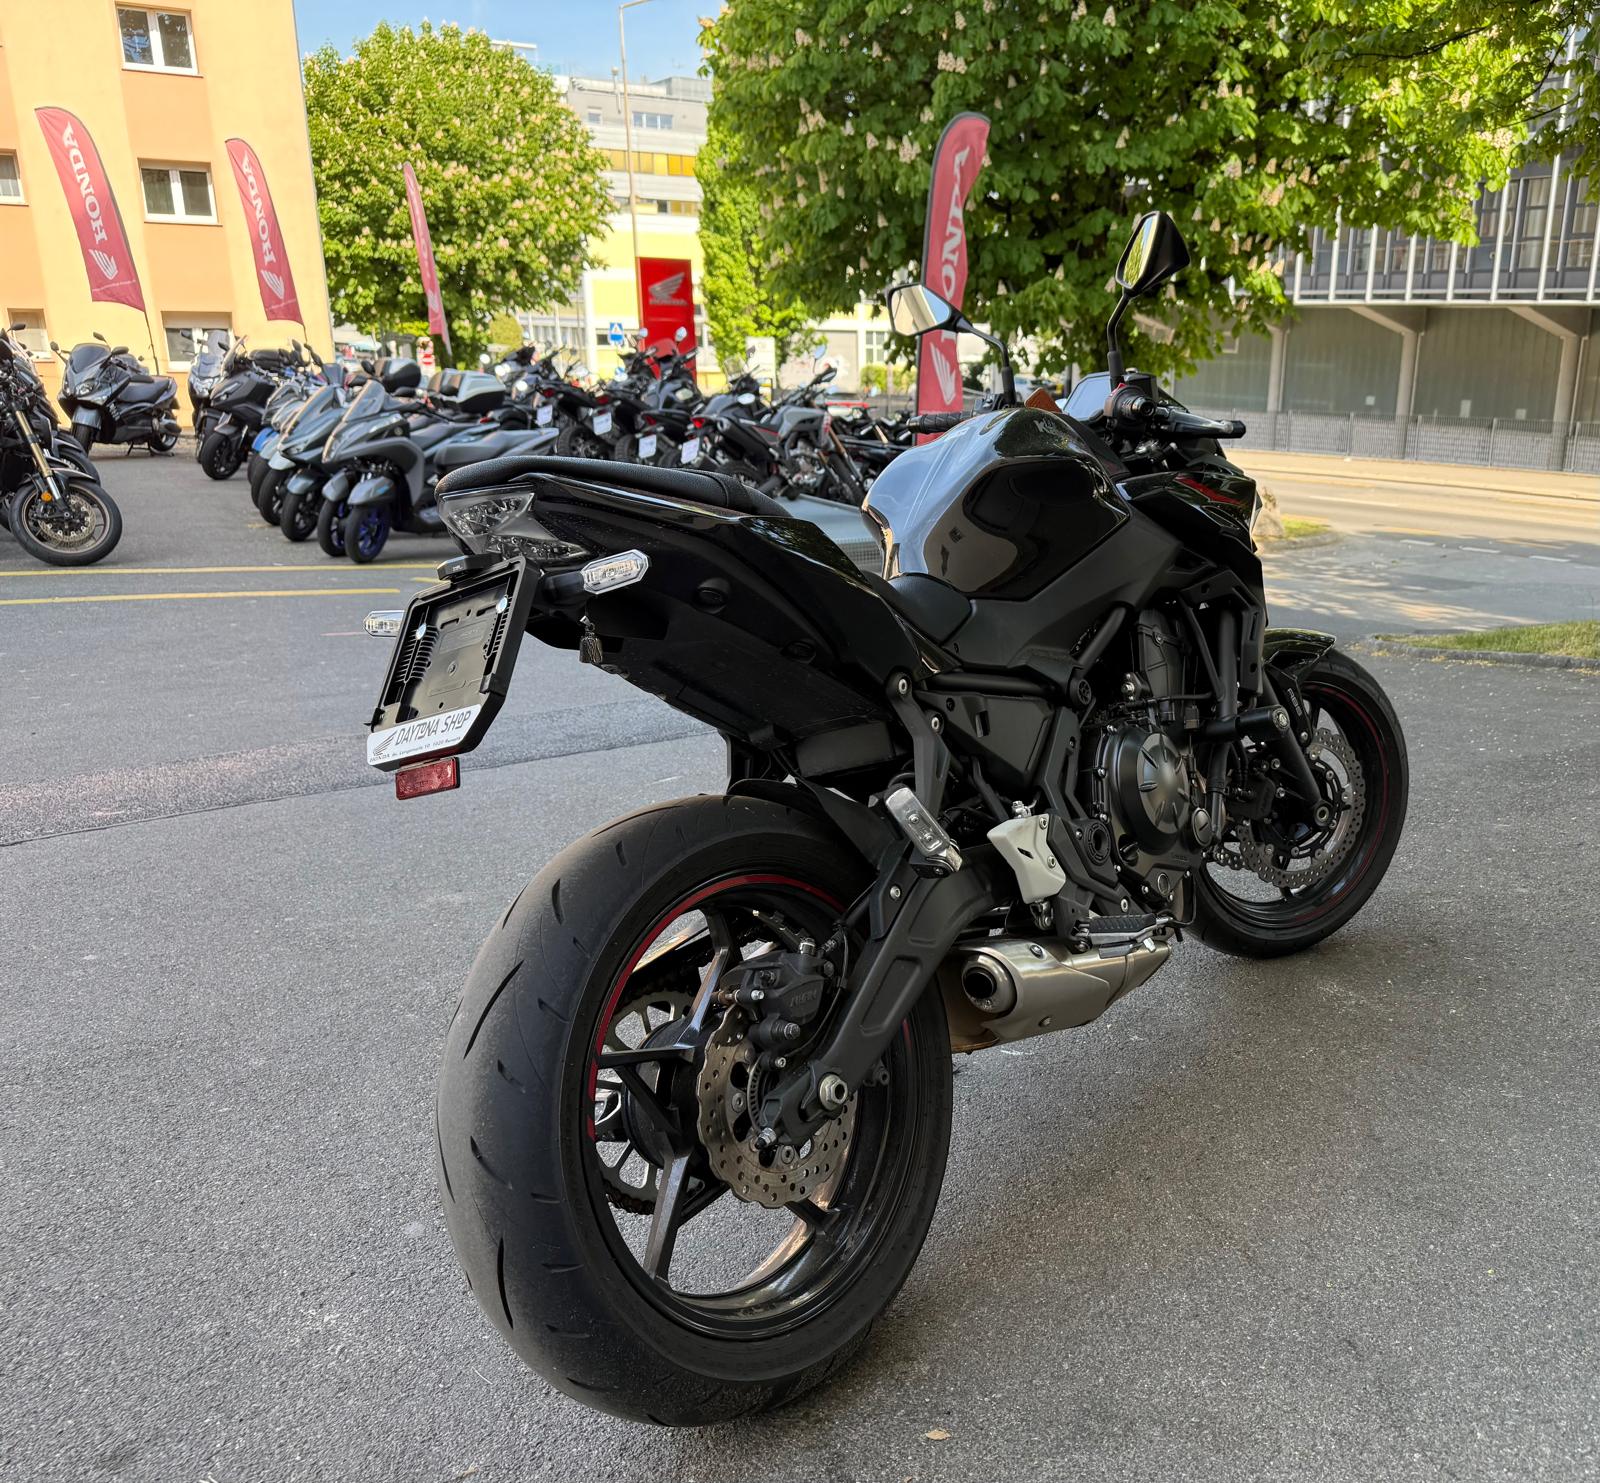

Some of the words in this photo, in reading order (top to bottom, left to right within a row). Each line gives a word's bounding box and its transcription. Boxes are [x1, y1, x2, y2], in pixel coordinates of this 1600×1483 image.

[62, 121, 108, 245] HONDA
[242, 151, 277, 266] HONDA
[395, 719, 440, 746] DAYTONA
[440, 710, 472, 733] SHOP
